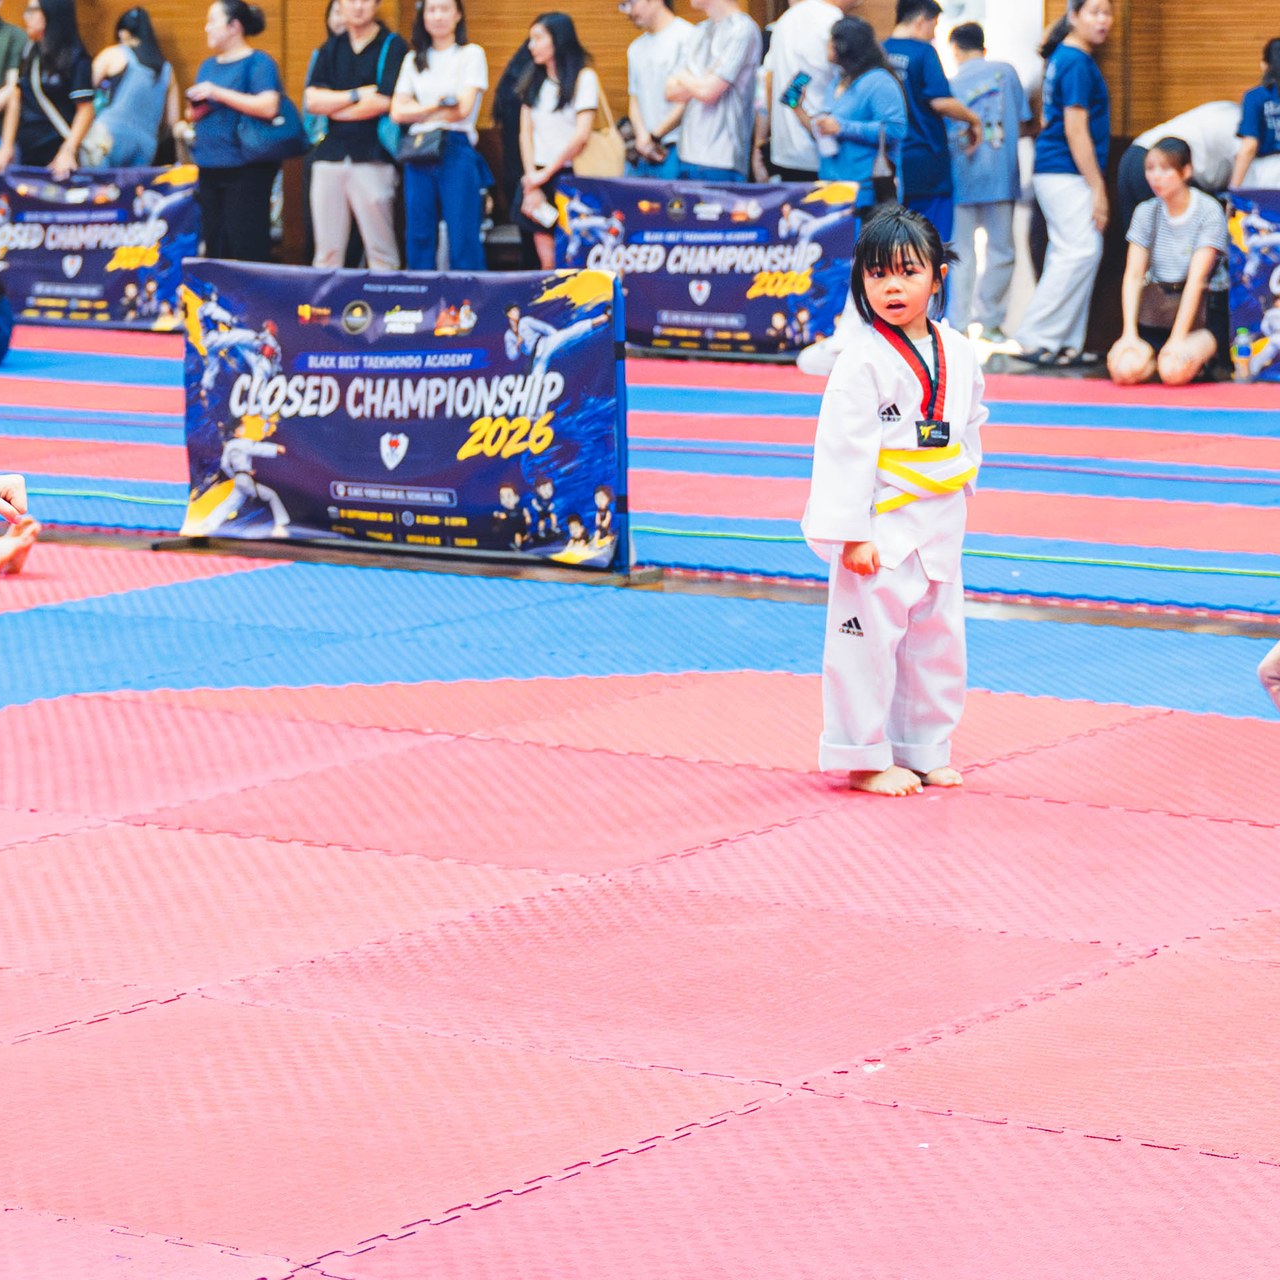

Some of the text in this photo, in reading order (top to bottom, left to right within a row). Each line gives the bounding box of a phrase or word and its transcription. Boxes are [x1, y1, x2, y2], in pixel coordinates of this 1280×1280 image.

[587, 241, 822, 274] CLOSED CHAMPIONSHIP
[230, 371, 564, 421] CLOSED CHAMPIONSHIP
[456, 411, 556, 461] 2026
